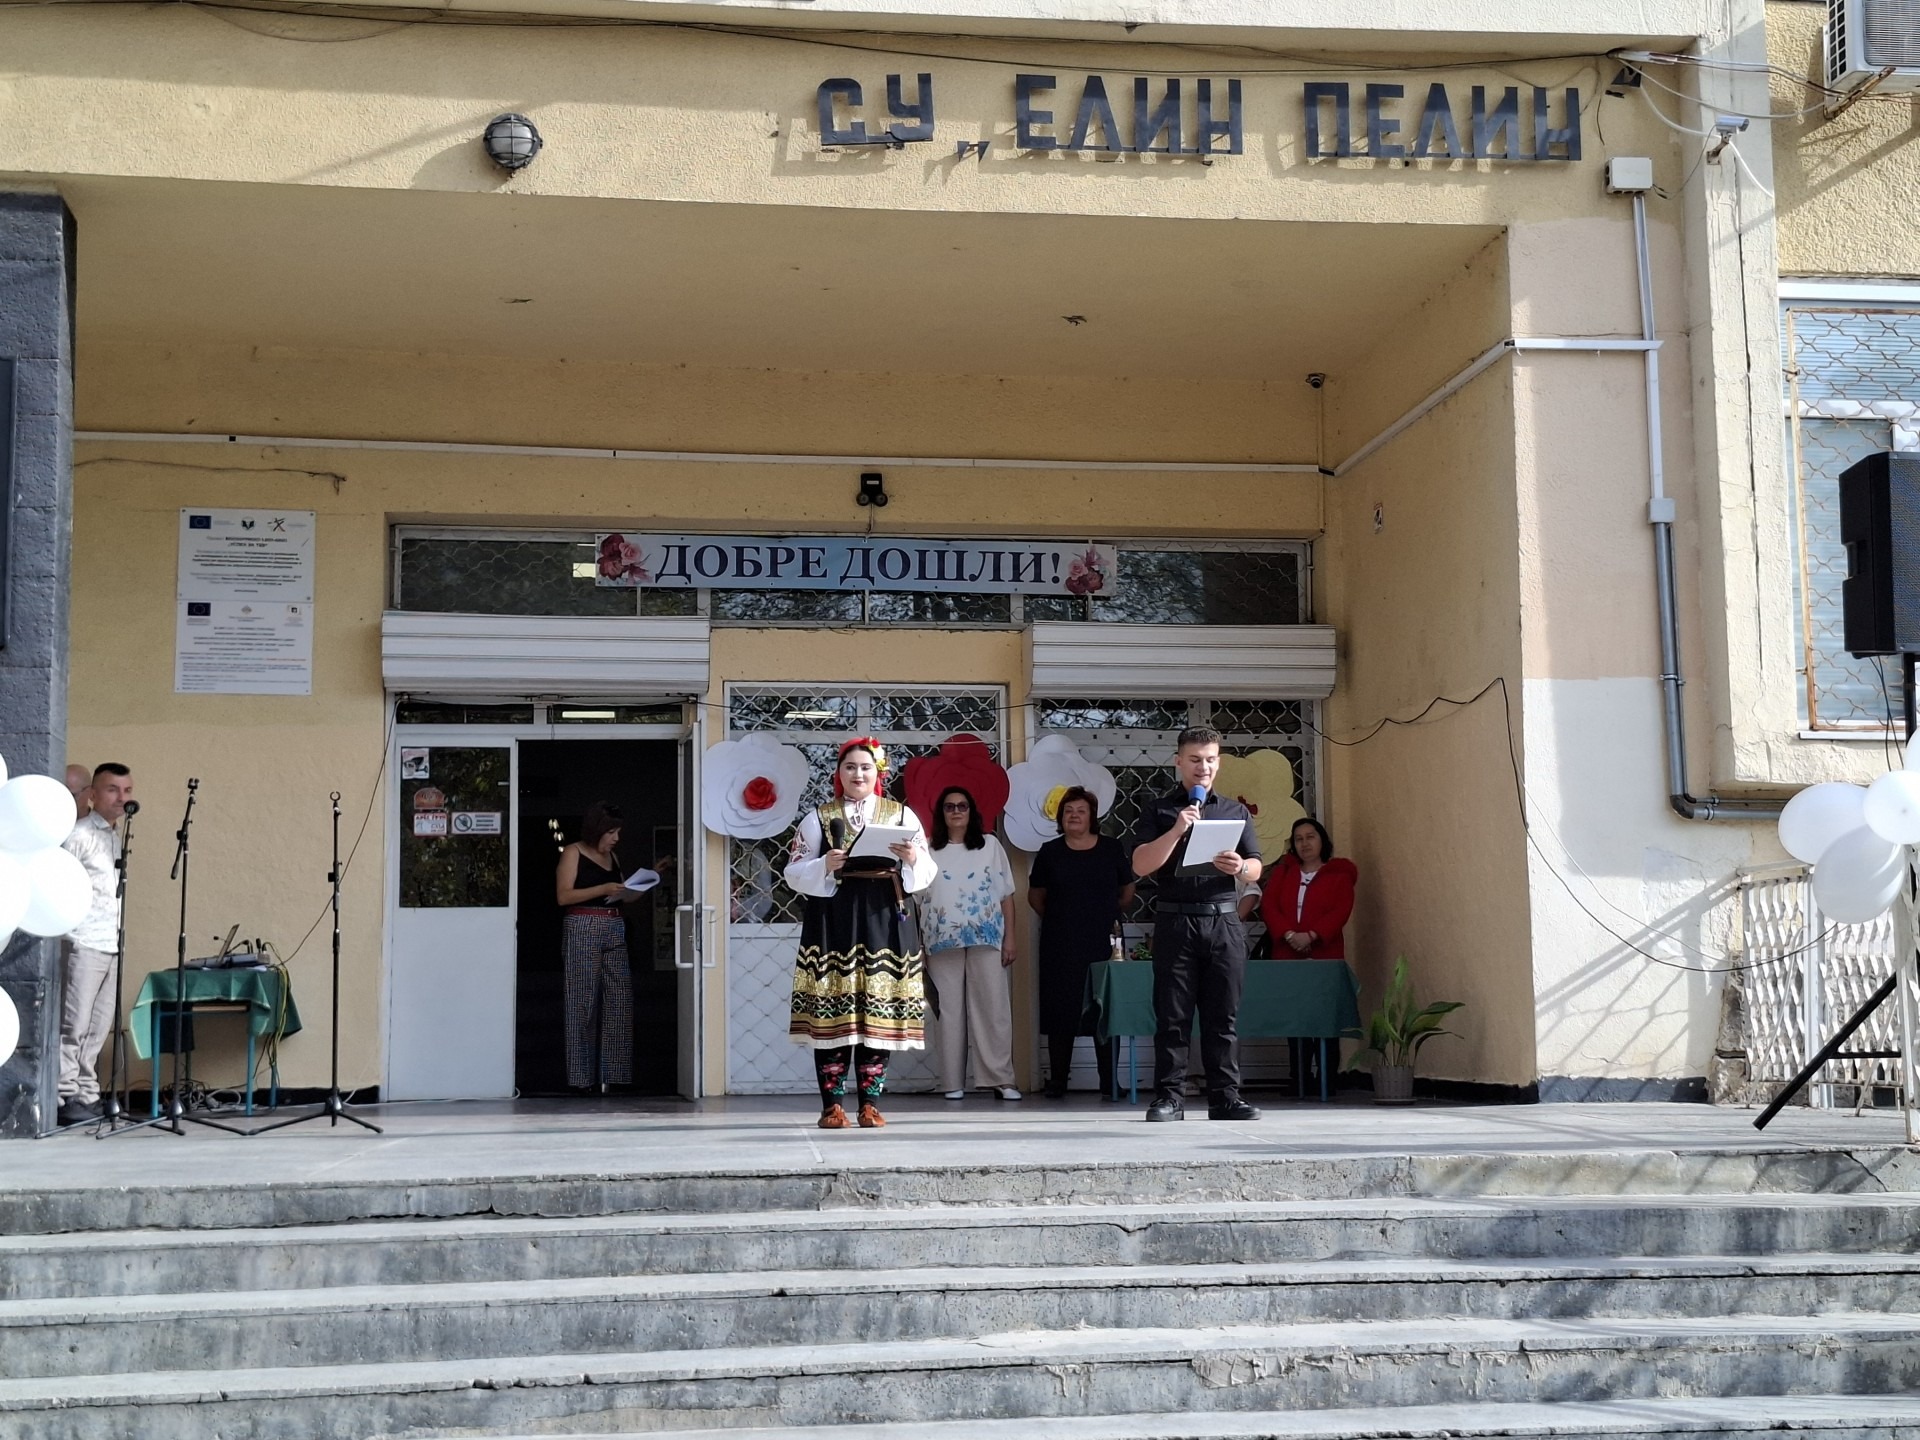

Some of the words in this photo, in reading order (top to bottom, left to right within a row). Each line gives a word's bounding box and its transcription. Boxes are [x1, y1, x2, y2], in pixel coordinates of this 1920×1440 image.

[817, 73, 934, 146] СУ
[654, 543, 829, 585] ДОБРЕ
[839, 546, 1061, 587] ДОШЛИ!
